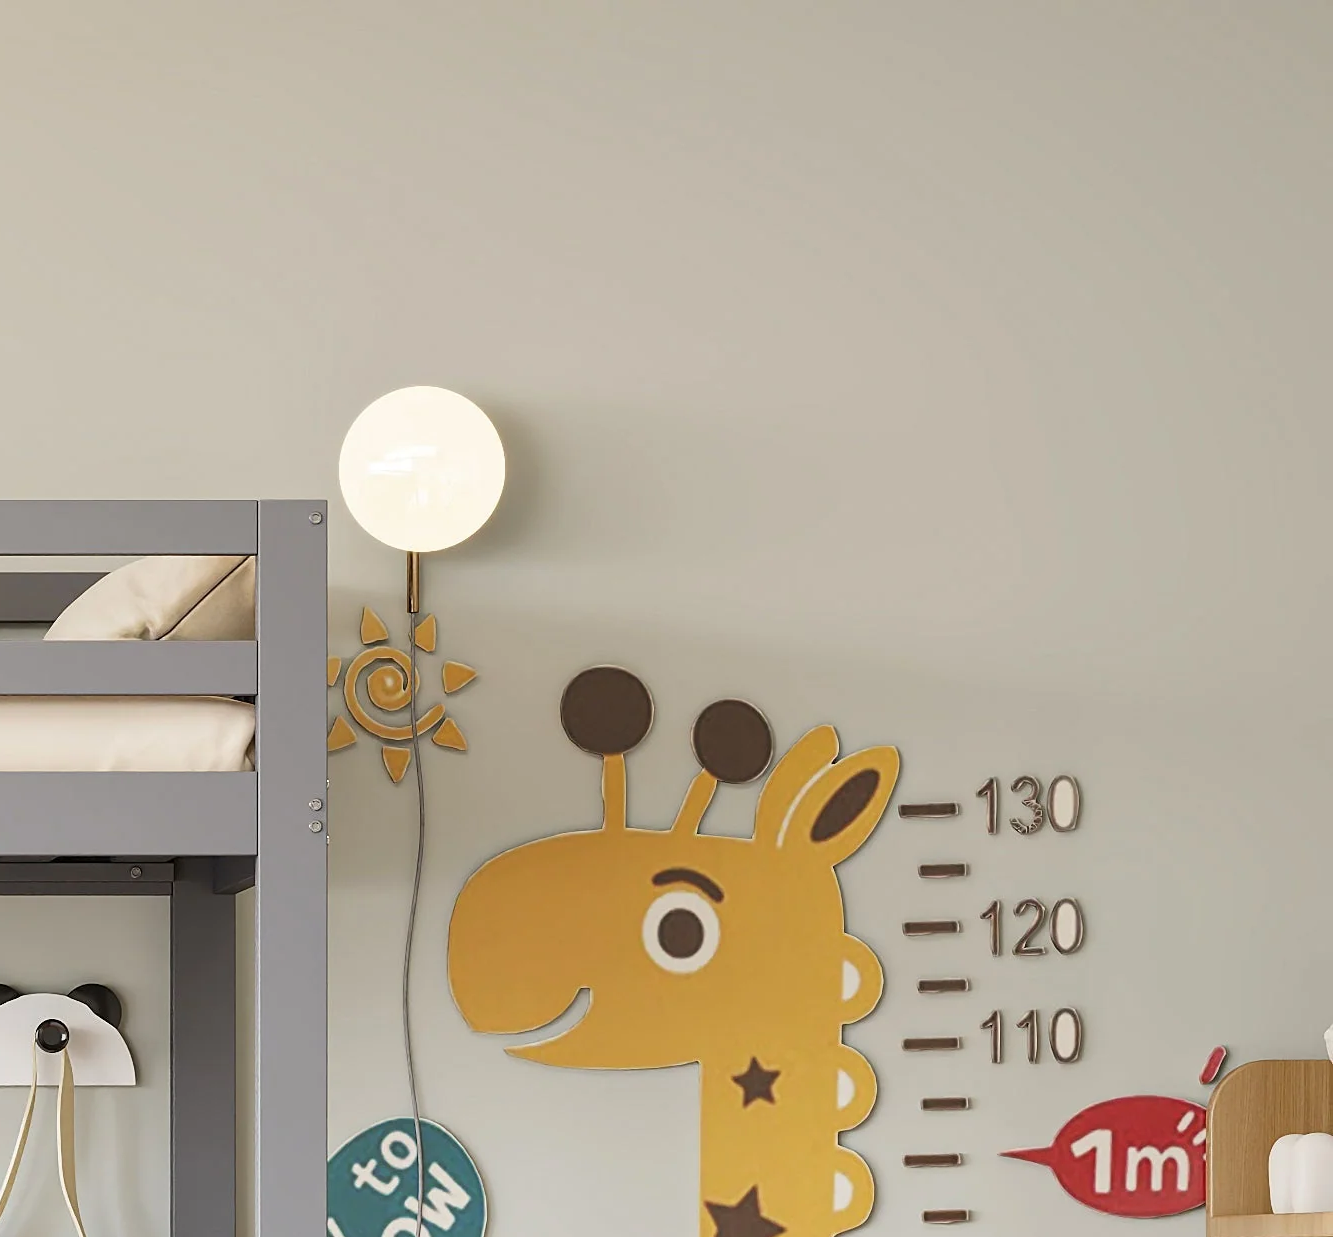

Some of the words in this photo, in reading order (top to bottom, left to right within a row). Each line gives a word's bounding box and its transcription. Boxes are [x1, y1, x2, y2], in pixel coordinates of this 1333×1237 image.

[976, 774, 1081, 836] 130
[979, 897, 1084, 957] 120
[979, 1007, 1082, 1065] 110
[350, 1130, 418, 1196] to
